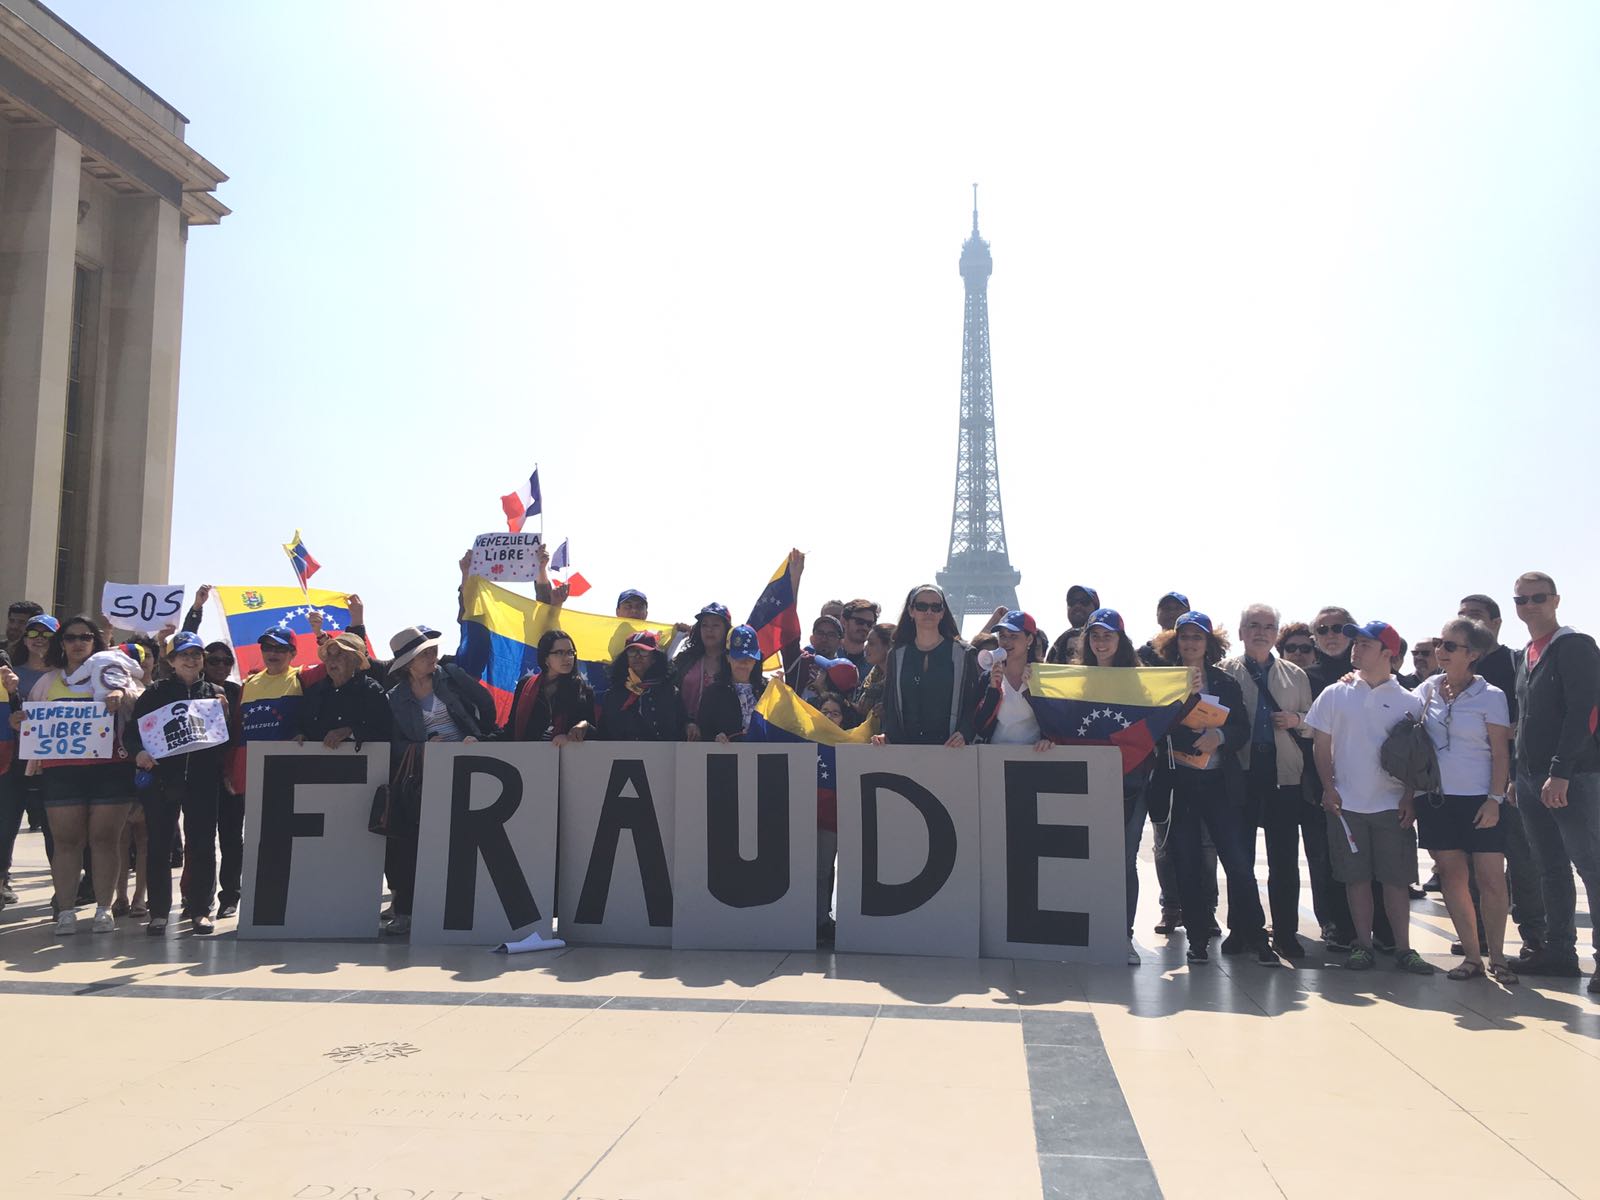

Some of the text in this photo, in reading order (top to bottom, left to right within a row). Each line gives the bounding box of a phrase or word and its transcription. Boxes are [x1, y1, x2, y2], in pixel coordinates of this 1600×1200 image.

[475, 535, 540, 547] VENEZUELA
[485, 549, 524, 561] LIBRE
[110, 589, 184, 622] SOS
[38, 721, 92, 739] LIBRE
[243, 721, 280, 731] VENEZUELA
[33, 737, 87, 755] SOS
[253, 753, 1090, 947] FRAUDE
